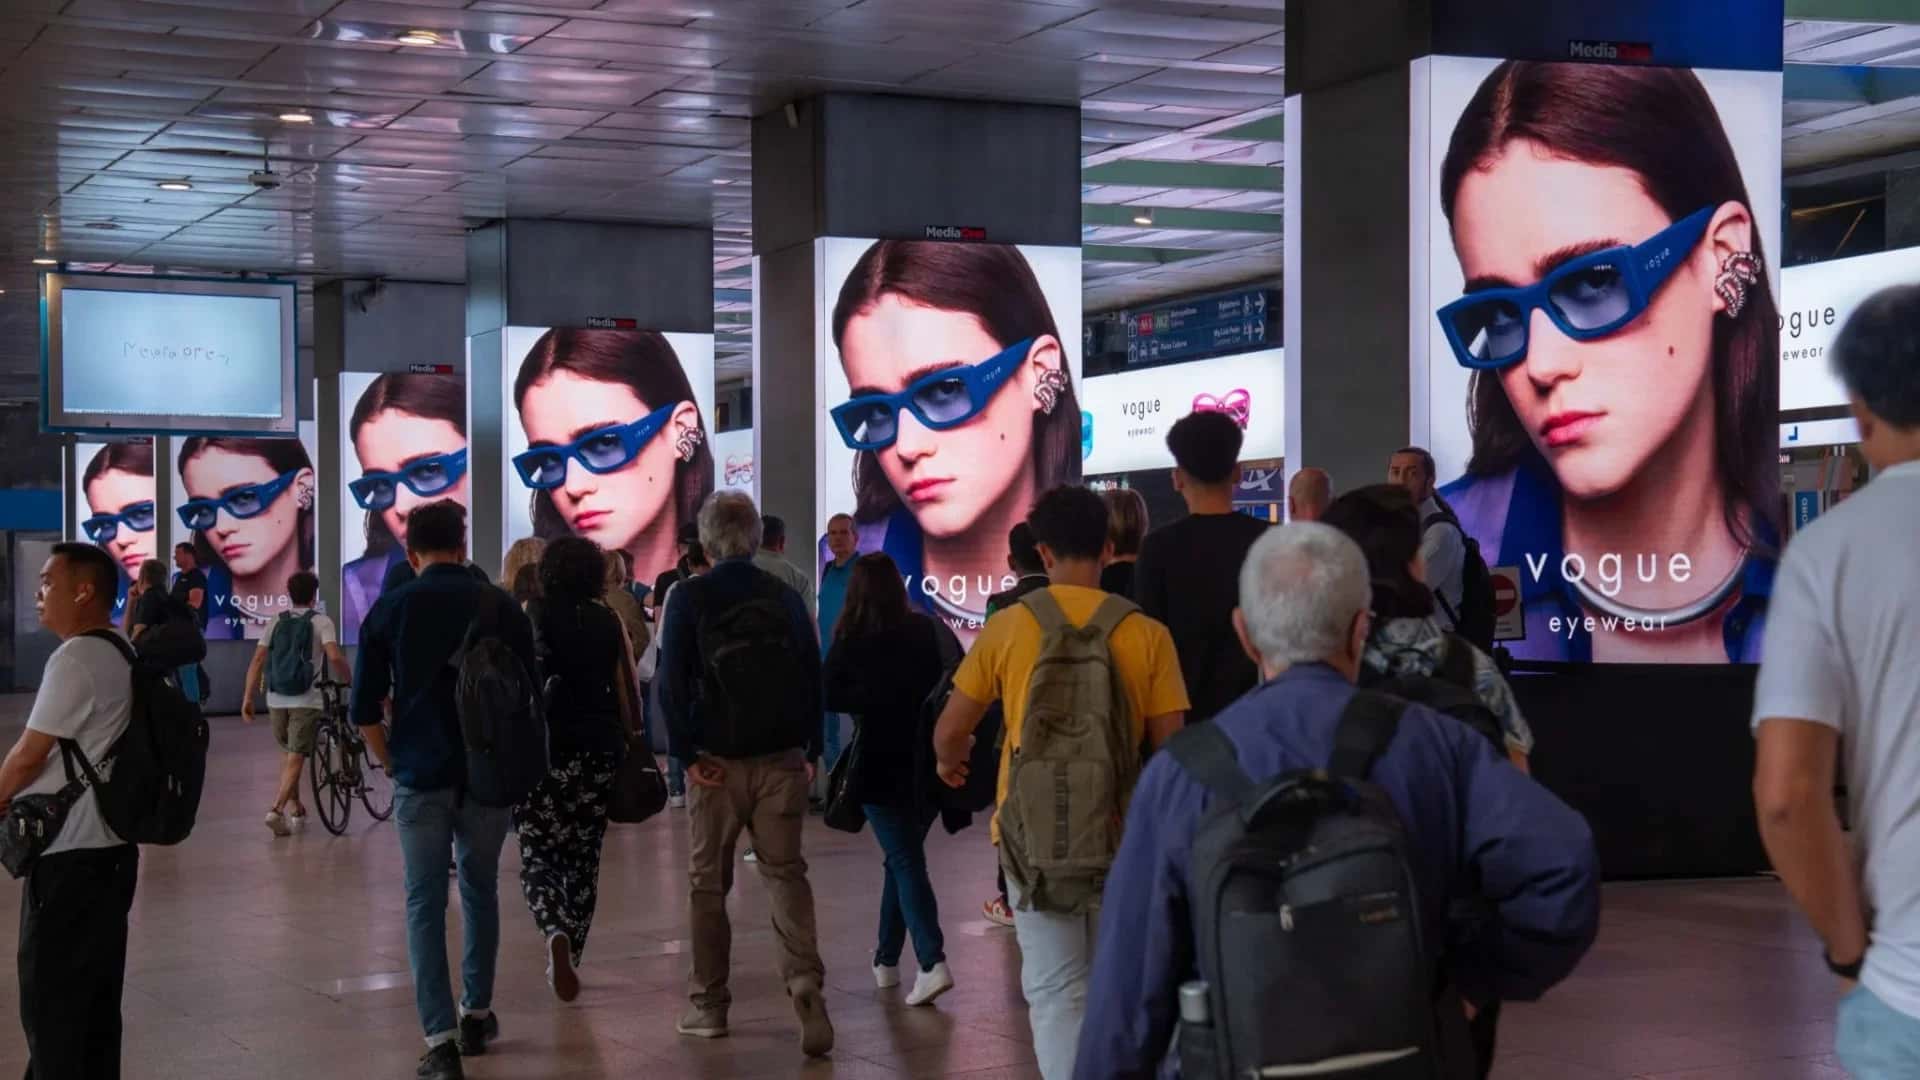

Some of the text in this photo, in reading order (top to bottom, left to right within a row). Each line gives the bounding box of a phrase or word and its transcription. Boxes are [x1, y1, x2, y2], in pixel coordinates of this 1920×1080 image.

[1778, 307, 1836, 338] ogue
[1783, 347, 1824, 360] ewear
[1122, 399, 1161, 421] vogue
[1525, 552, 1692, 596] vogue
[214, 594, 289, 612] vogue
[1549, 614, 1668, 639] eyewear
